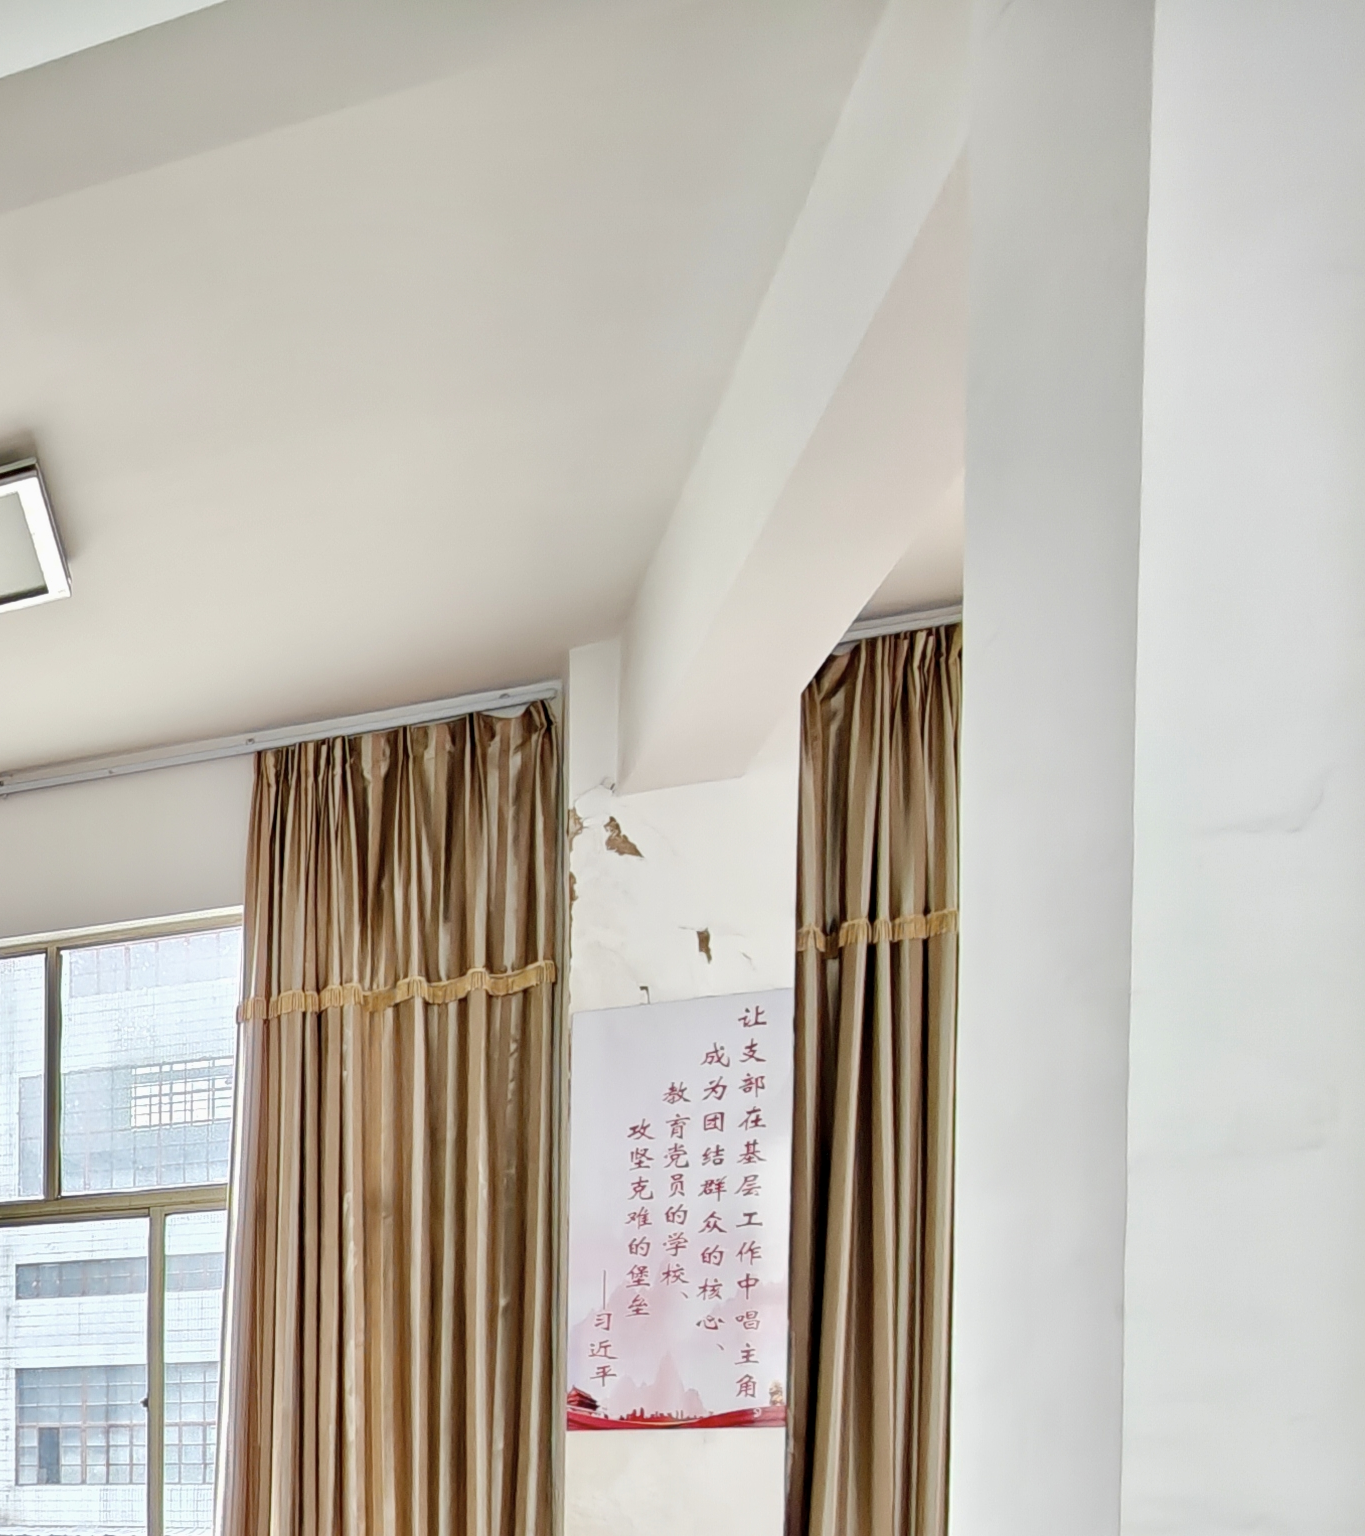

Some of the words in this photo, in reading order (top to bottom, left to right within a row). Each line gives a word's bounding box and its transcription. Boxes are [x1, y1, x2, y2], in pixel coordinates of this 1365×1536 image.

[625, 1117, 655, 1319] 攻坚克难的堡垒
[661, 1080, 693, 1302] 教育党员的学校、
[695, 1040, 732, 1354] 成为团结群众的核心、
[735, 1005, 768, 1399] 让支部在基层工作中唱主角
